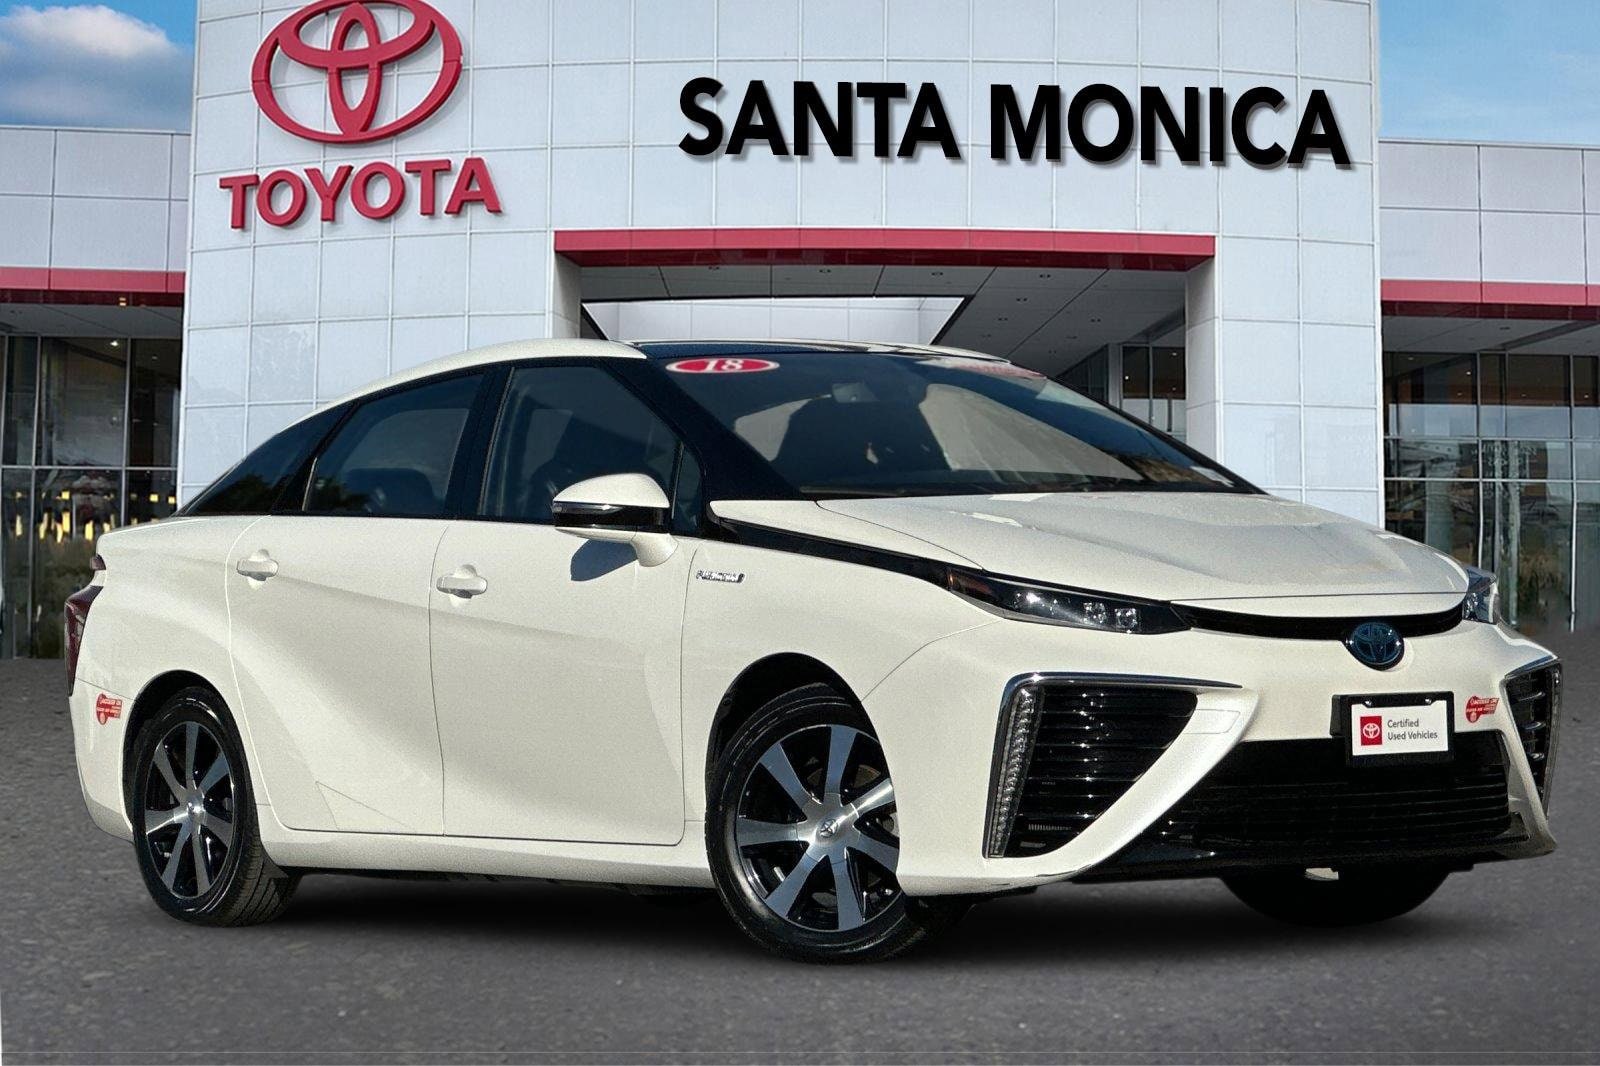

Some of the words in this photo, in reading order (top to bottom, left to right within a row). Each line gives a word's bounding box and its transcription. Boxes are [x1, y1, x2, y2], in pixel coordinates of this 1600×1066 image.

[679, 77, 961, 158] SANTA
[990, 84, 1350, 168] MONICA
[219, 157, 502, 229] TOYOTA
[703, 359, 744, 372] 18
[1387, 719, 1420, 728] Certified
[1387, 731, 1407, 741] Used
[1408, 731, 1438, 740] Vehicles
